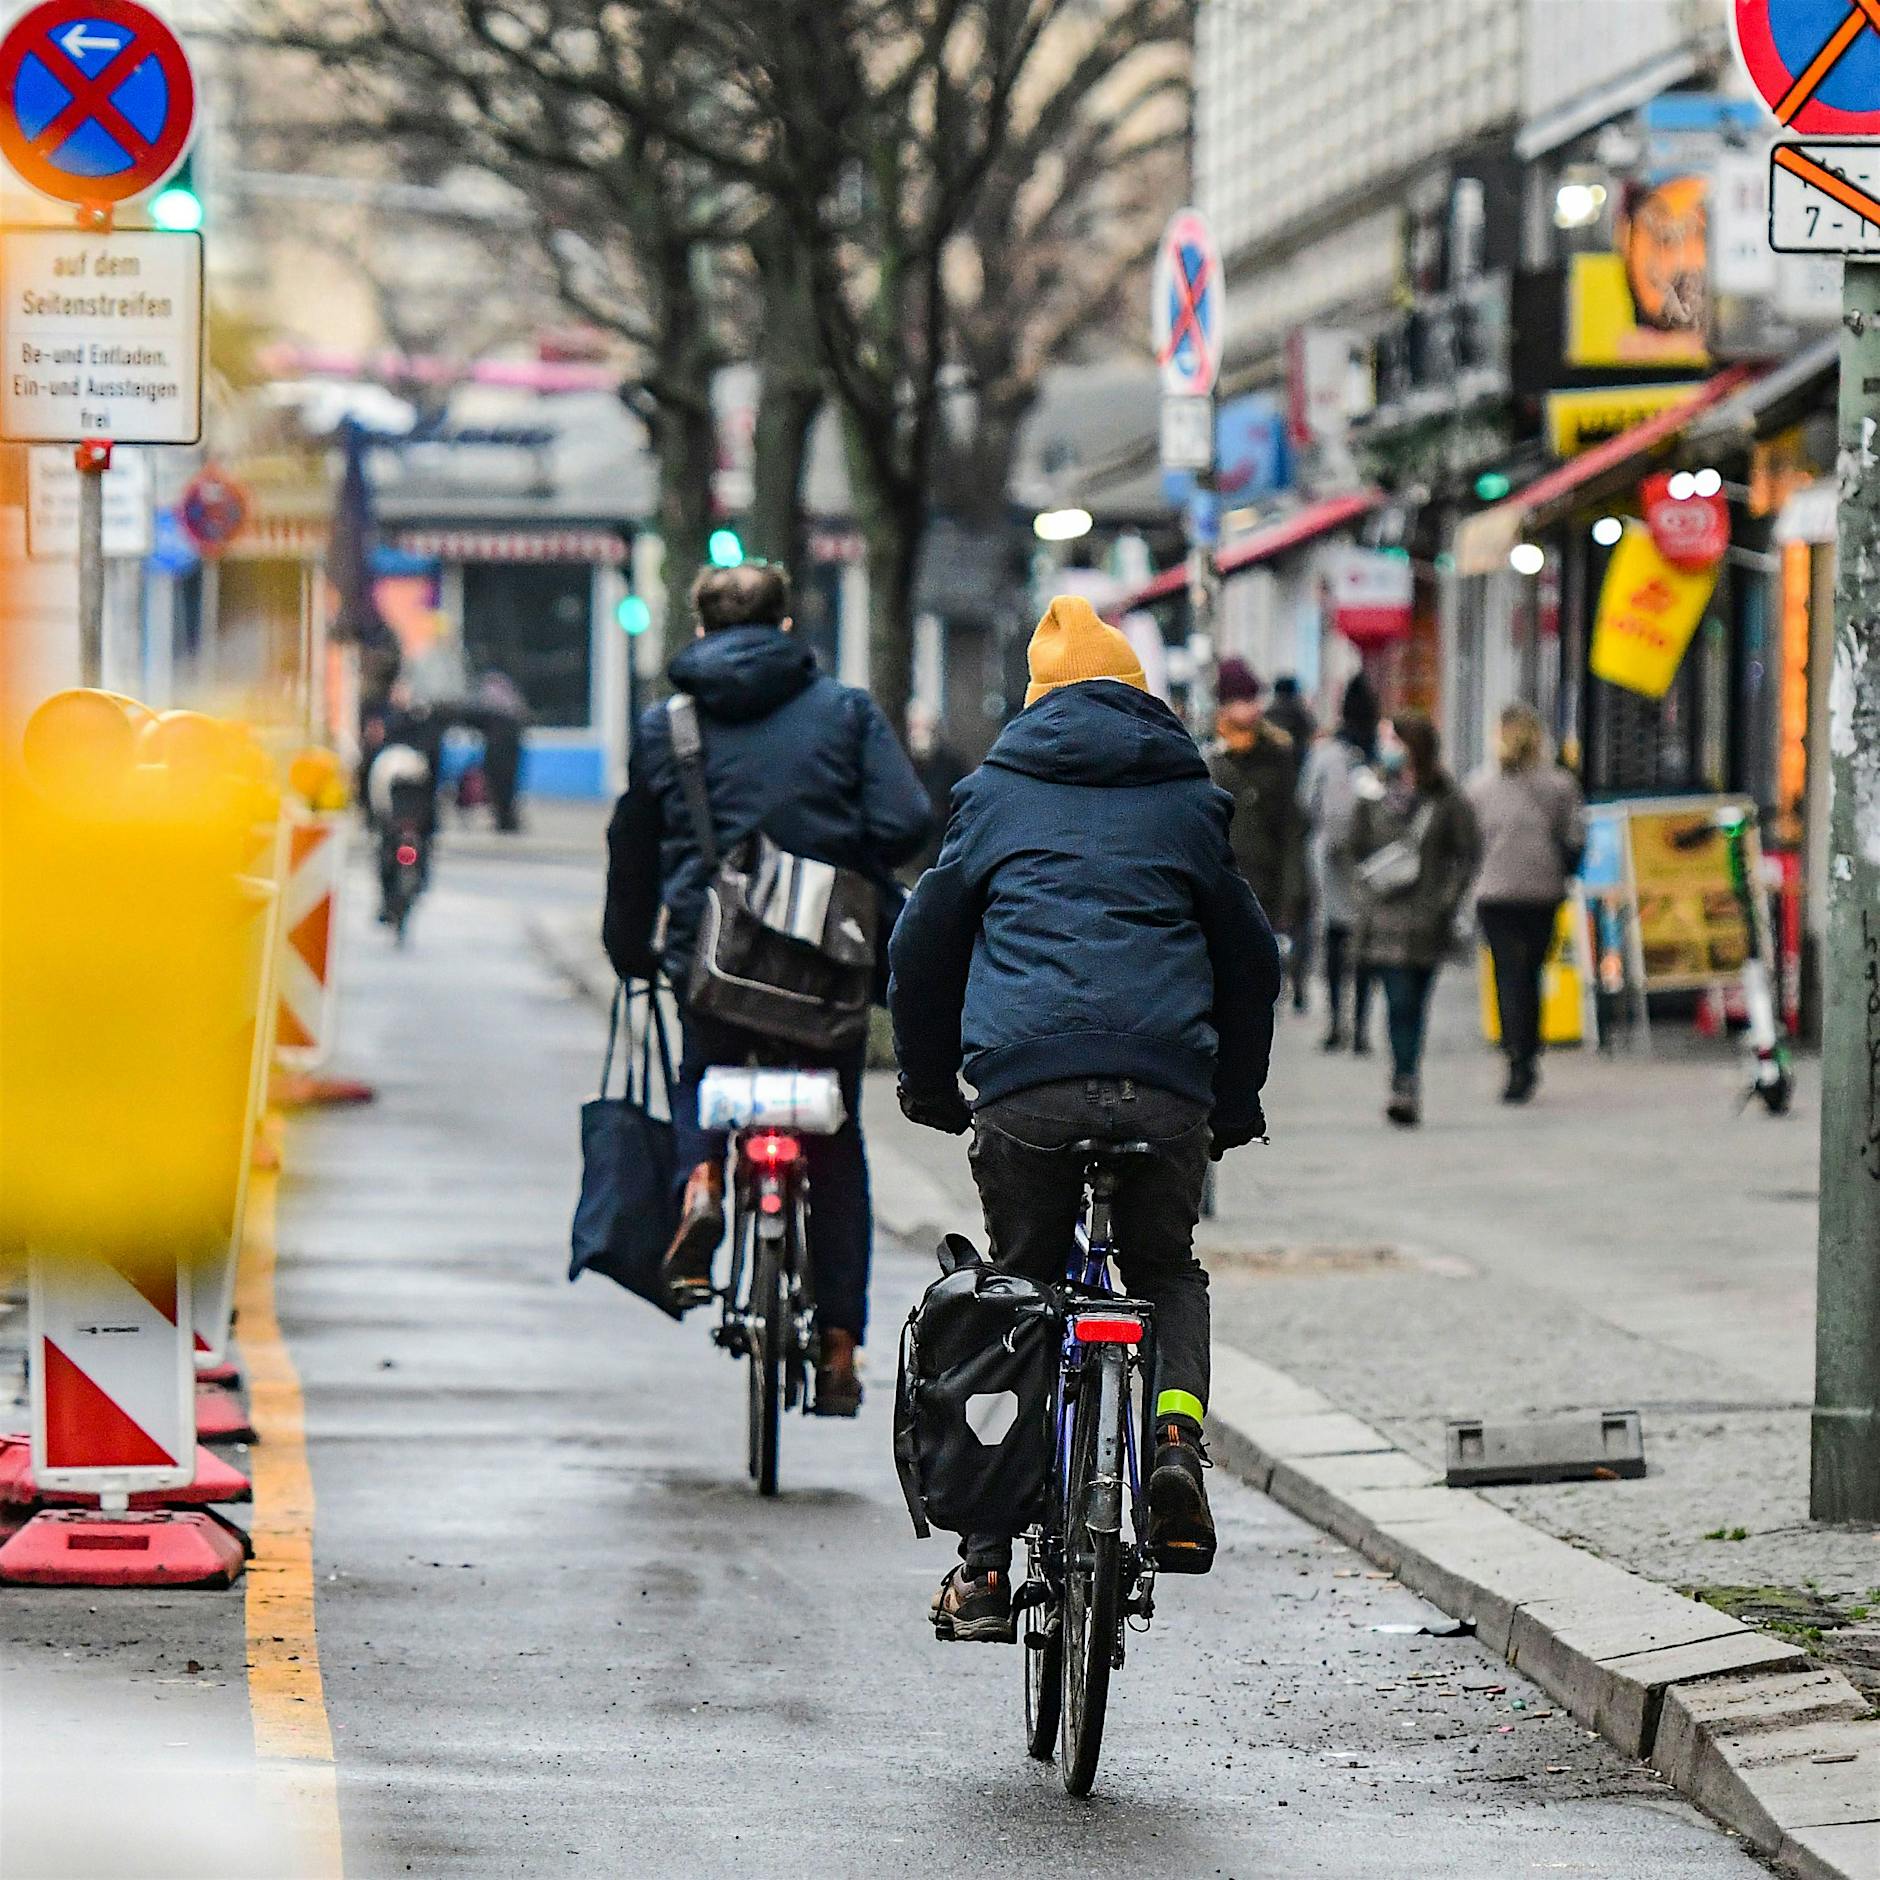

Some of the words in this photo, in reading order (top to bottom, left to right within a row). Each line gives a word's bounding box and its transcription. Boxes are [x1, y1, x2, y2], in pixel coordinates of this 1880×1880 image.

[54, 249, 87, 277] auf
[94, 250, 141, 277] dem
[22, 289, 172, 317] Seitenstreifen
[86, 375, 178, 404] Aussteigen
[80, 407, 111, 428] frei
